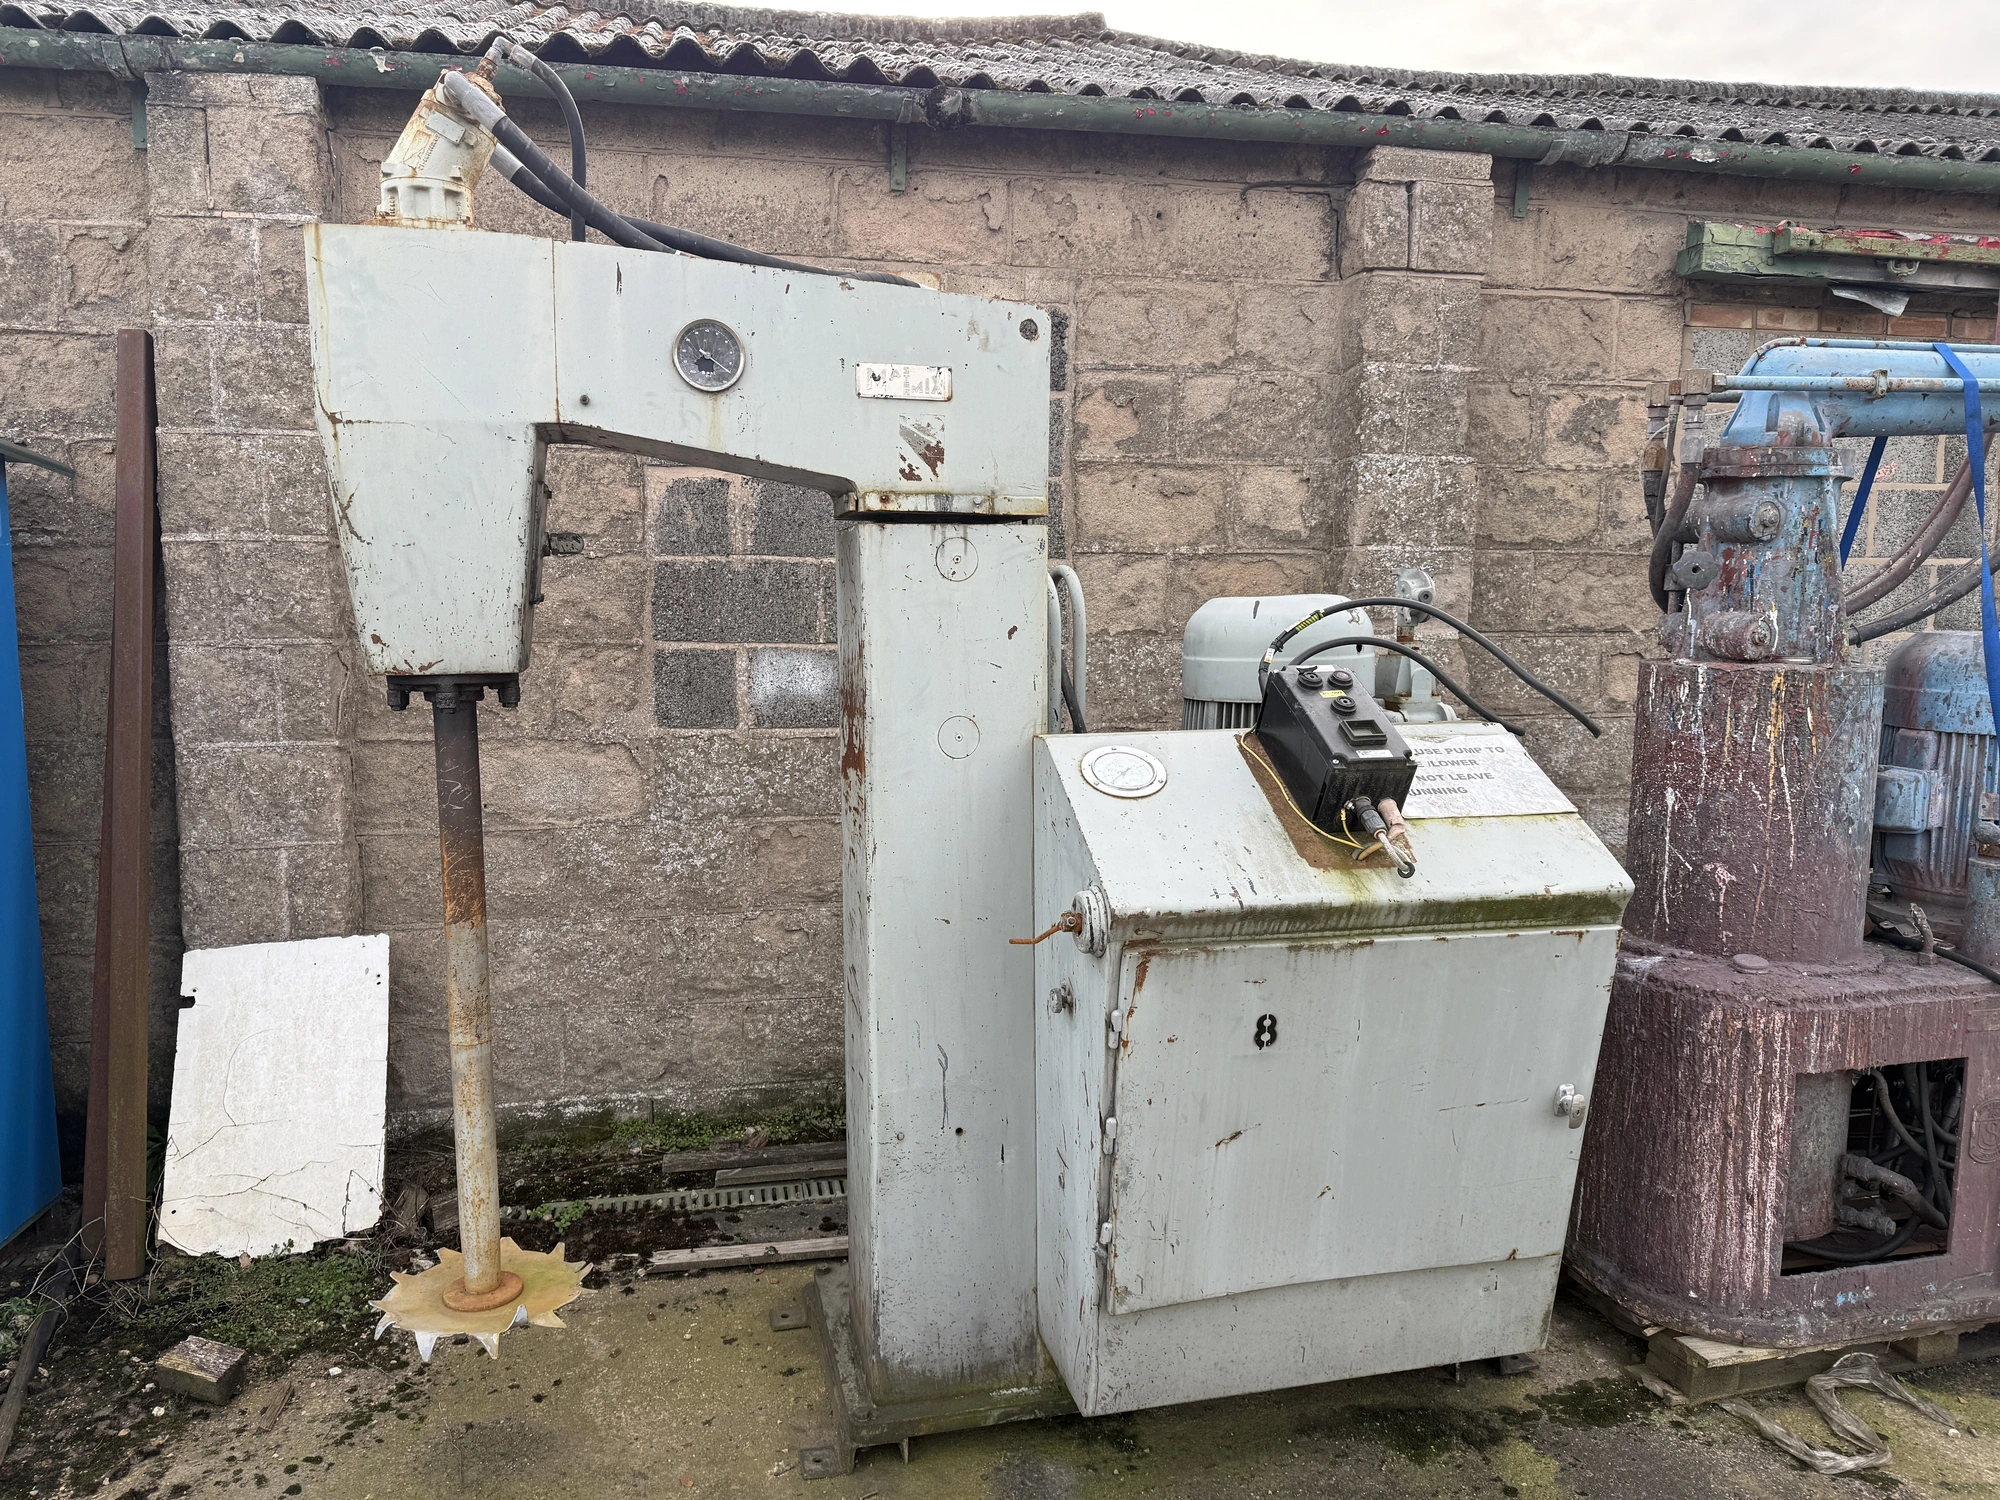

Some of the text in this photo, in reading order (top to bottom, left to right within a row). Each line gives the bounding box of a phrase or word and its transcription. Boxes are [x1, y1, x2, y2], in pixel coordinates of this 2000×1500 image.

[1444, 747, 1482, 755] PUMP
[1485, 746, 1506, 754] TO
[1415, 772, 1494, 782] NOT LEAVE
[1254, 1013, 1277, 1050] 8
